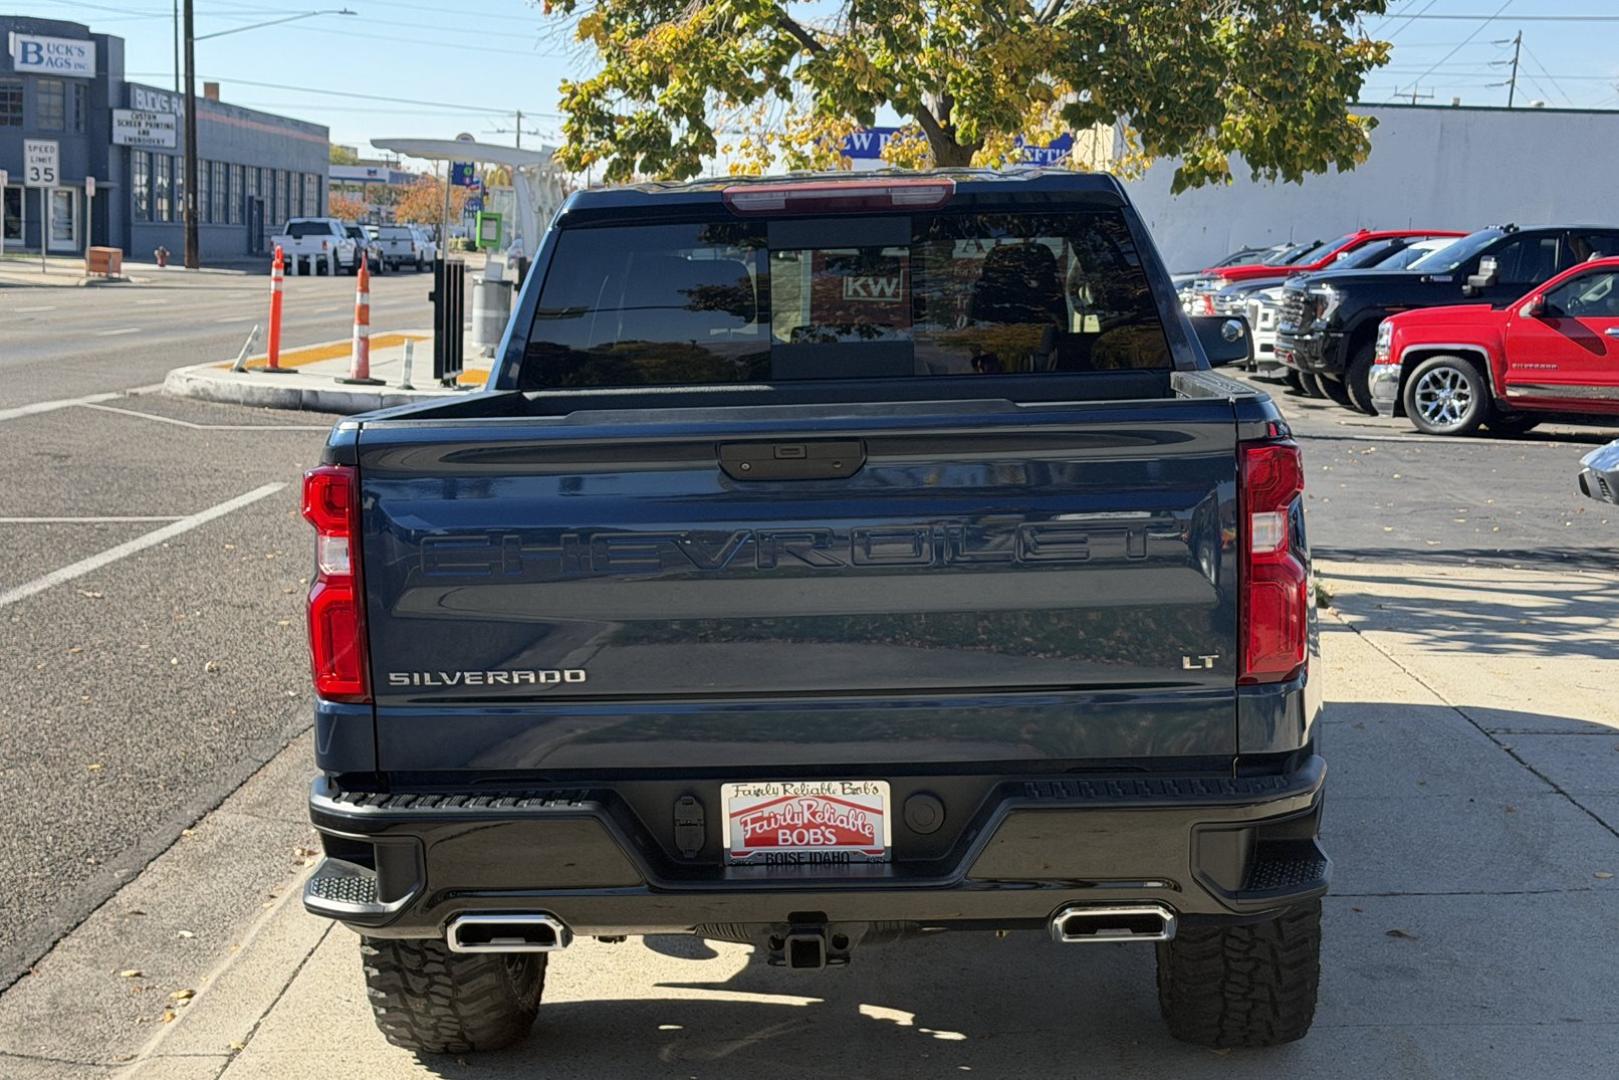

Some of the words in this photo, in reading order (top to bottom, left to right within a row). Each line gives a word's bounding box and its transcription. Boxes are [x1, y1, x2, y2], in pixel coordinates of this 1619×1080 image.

[117, 119, 142, 128] SCREEN
[145, 122, 174, 131] PRINTING
[28, 144, 56, 154] SPEED
[30, 155, 53, 164] LIMIT
[30, 166, 55, 182] 35
[420, 520, 1176, 576] CHEVROLET
[1182, 654, 1220, 669] LT
[388, 669, 587, 686] SILVERADO
[731, 783, 780, 798] Fairly
[781, 782, 837, 798] Reliable
[839, 782, 880, 796] Bob's
[740, 803, 803, 839] Fairly
[798, 799, 875, 838] Reliable
[777, 826, 838, 846] BOB'S
[765, 850, 805, 865] BOISE
[808, 850, 850, 865] IDAHO
